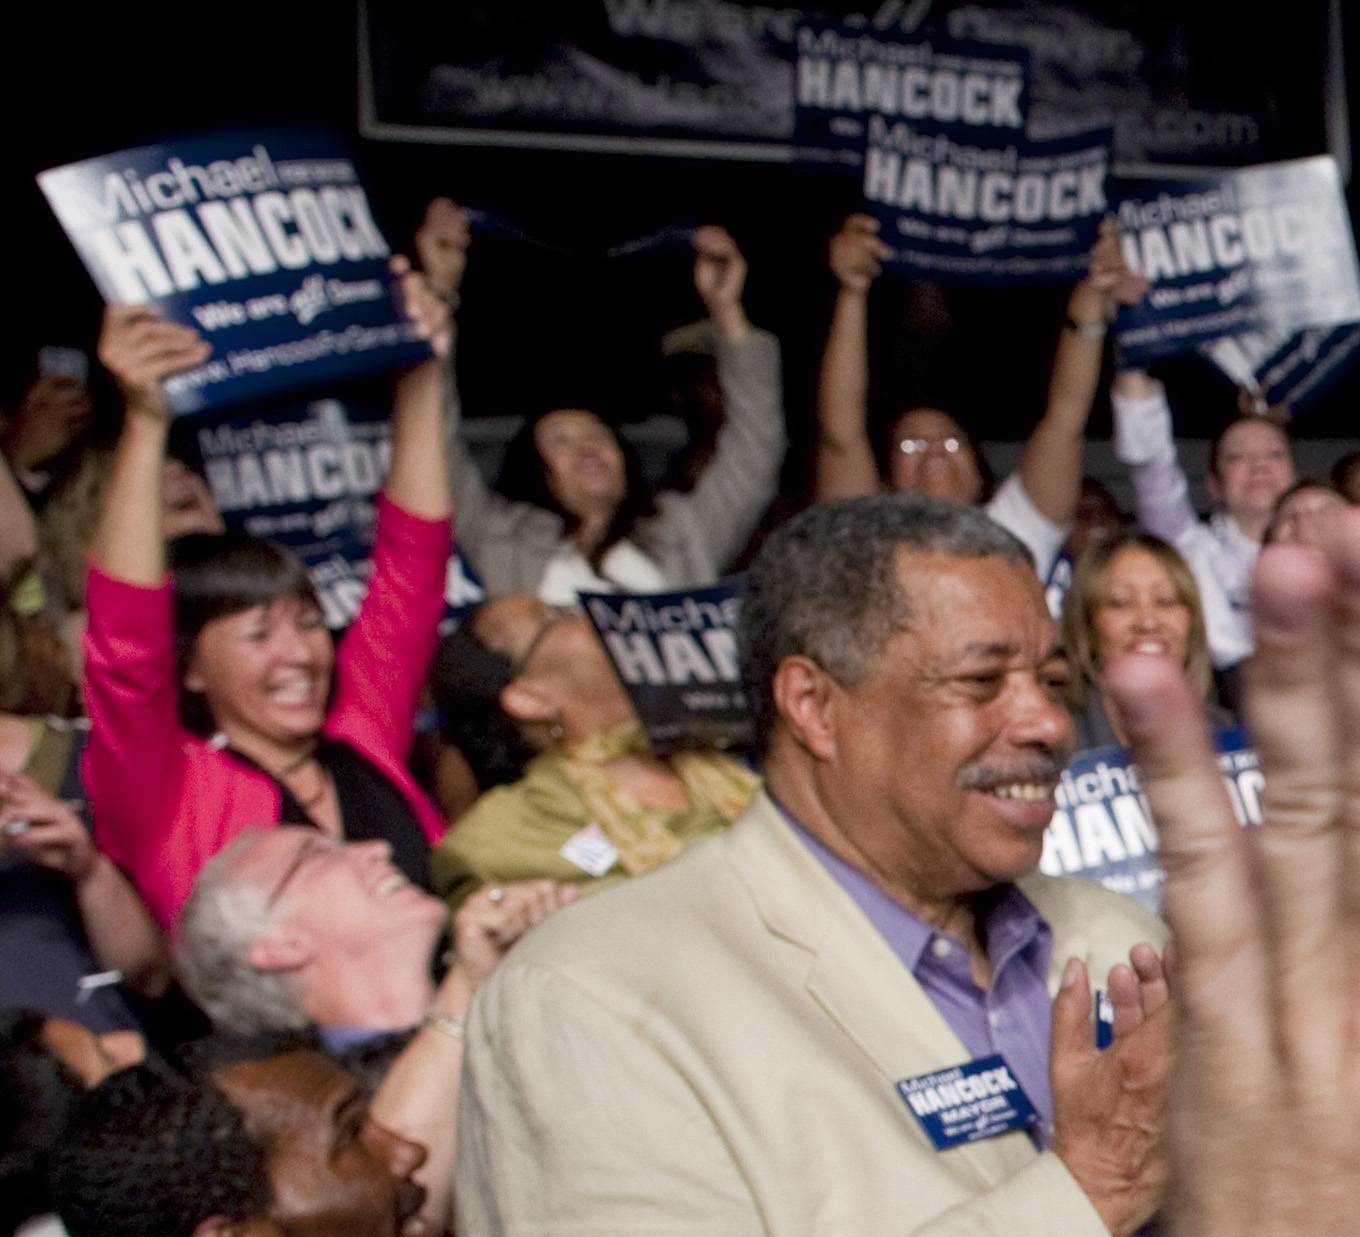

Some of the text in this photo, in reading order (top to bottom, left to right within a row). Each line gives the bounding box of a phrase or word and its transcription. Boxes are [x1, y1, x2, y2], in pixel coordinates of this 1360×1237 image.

[797, 56, 1024, 130] HANCOCK
[867, 113, 1018, 172] Michael
[863, 146, 1108, 224] HANCOCK
[906, 1065, 1018, 1117] HANCOCK
[940, 1095, 1010, 1125] MAYOR
